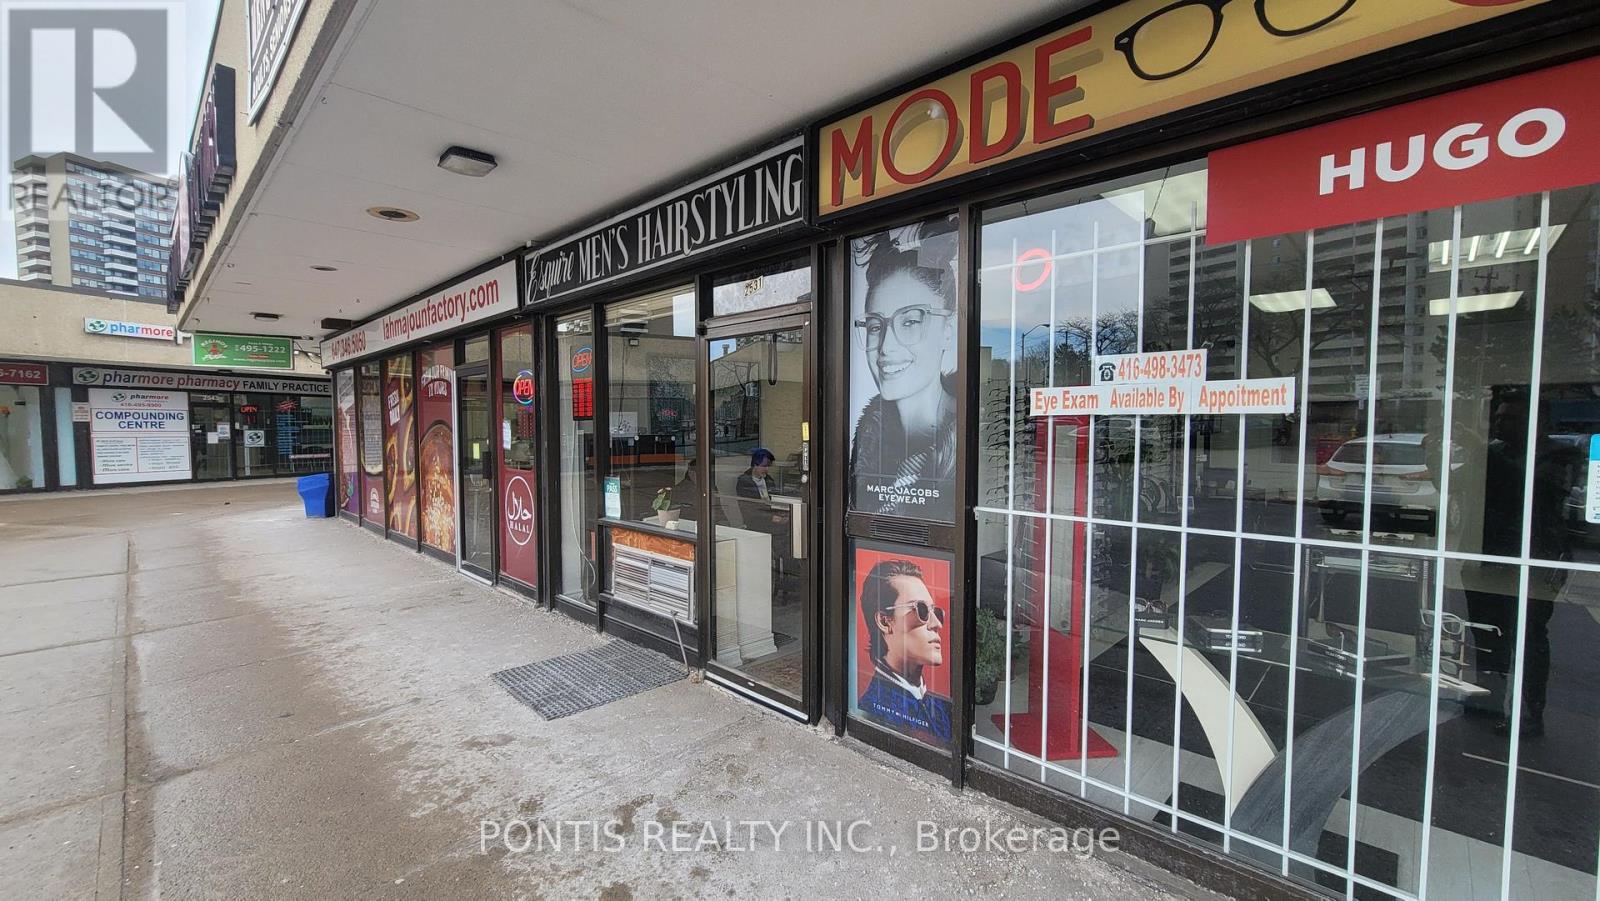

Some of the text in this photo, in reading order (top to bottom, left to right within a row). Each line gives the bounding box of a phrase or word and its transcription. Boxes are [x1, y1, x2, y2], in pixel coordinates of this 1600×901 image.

[831, 26, 1095, 207] MODE
[1319, 107, 1566, 196] HUGO
[528, 153, 804, 303] Esquire MEN'S HAIRSTYLING
[382, 279, 500, 341] lahmajounfactory.com
[109, 322, 174, 338] pharmore
[572, 351, 592, 369] OPEN
[1118, 352, 1202, 380] 416-498-3473
[102, 372, 330, 394] pharmore pharmacy FAMILY PRACTICE
[515, 378, 534, 397] OPEN
[1034, 384, 1287, 415] Eye Exam Available By Appoitment
[95, 411, 185, 420] COMPOUNDING
[240, 405, 258, 414] OPEN
[118, 421, 165, 429] CENTRE
[866, 484, 940, 498] MARC JACOBS
[878, 493, 926, 505] EYEWEAR
[509, 520, 531, 534] HALAL
[873, 702, 929, 728] TOMMY HILFIGER
